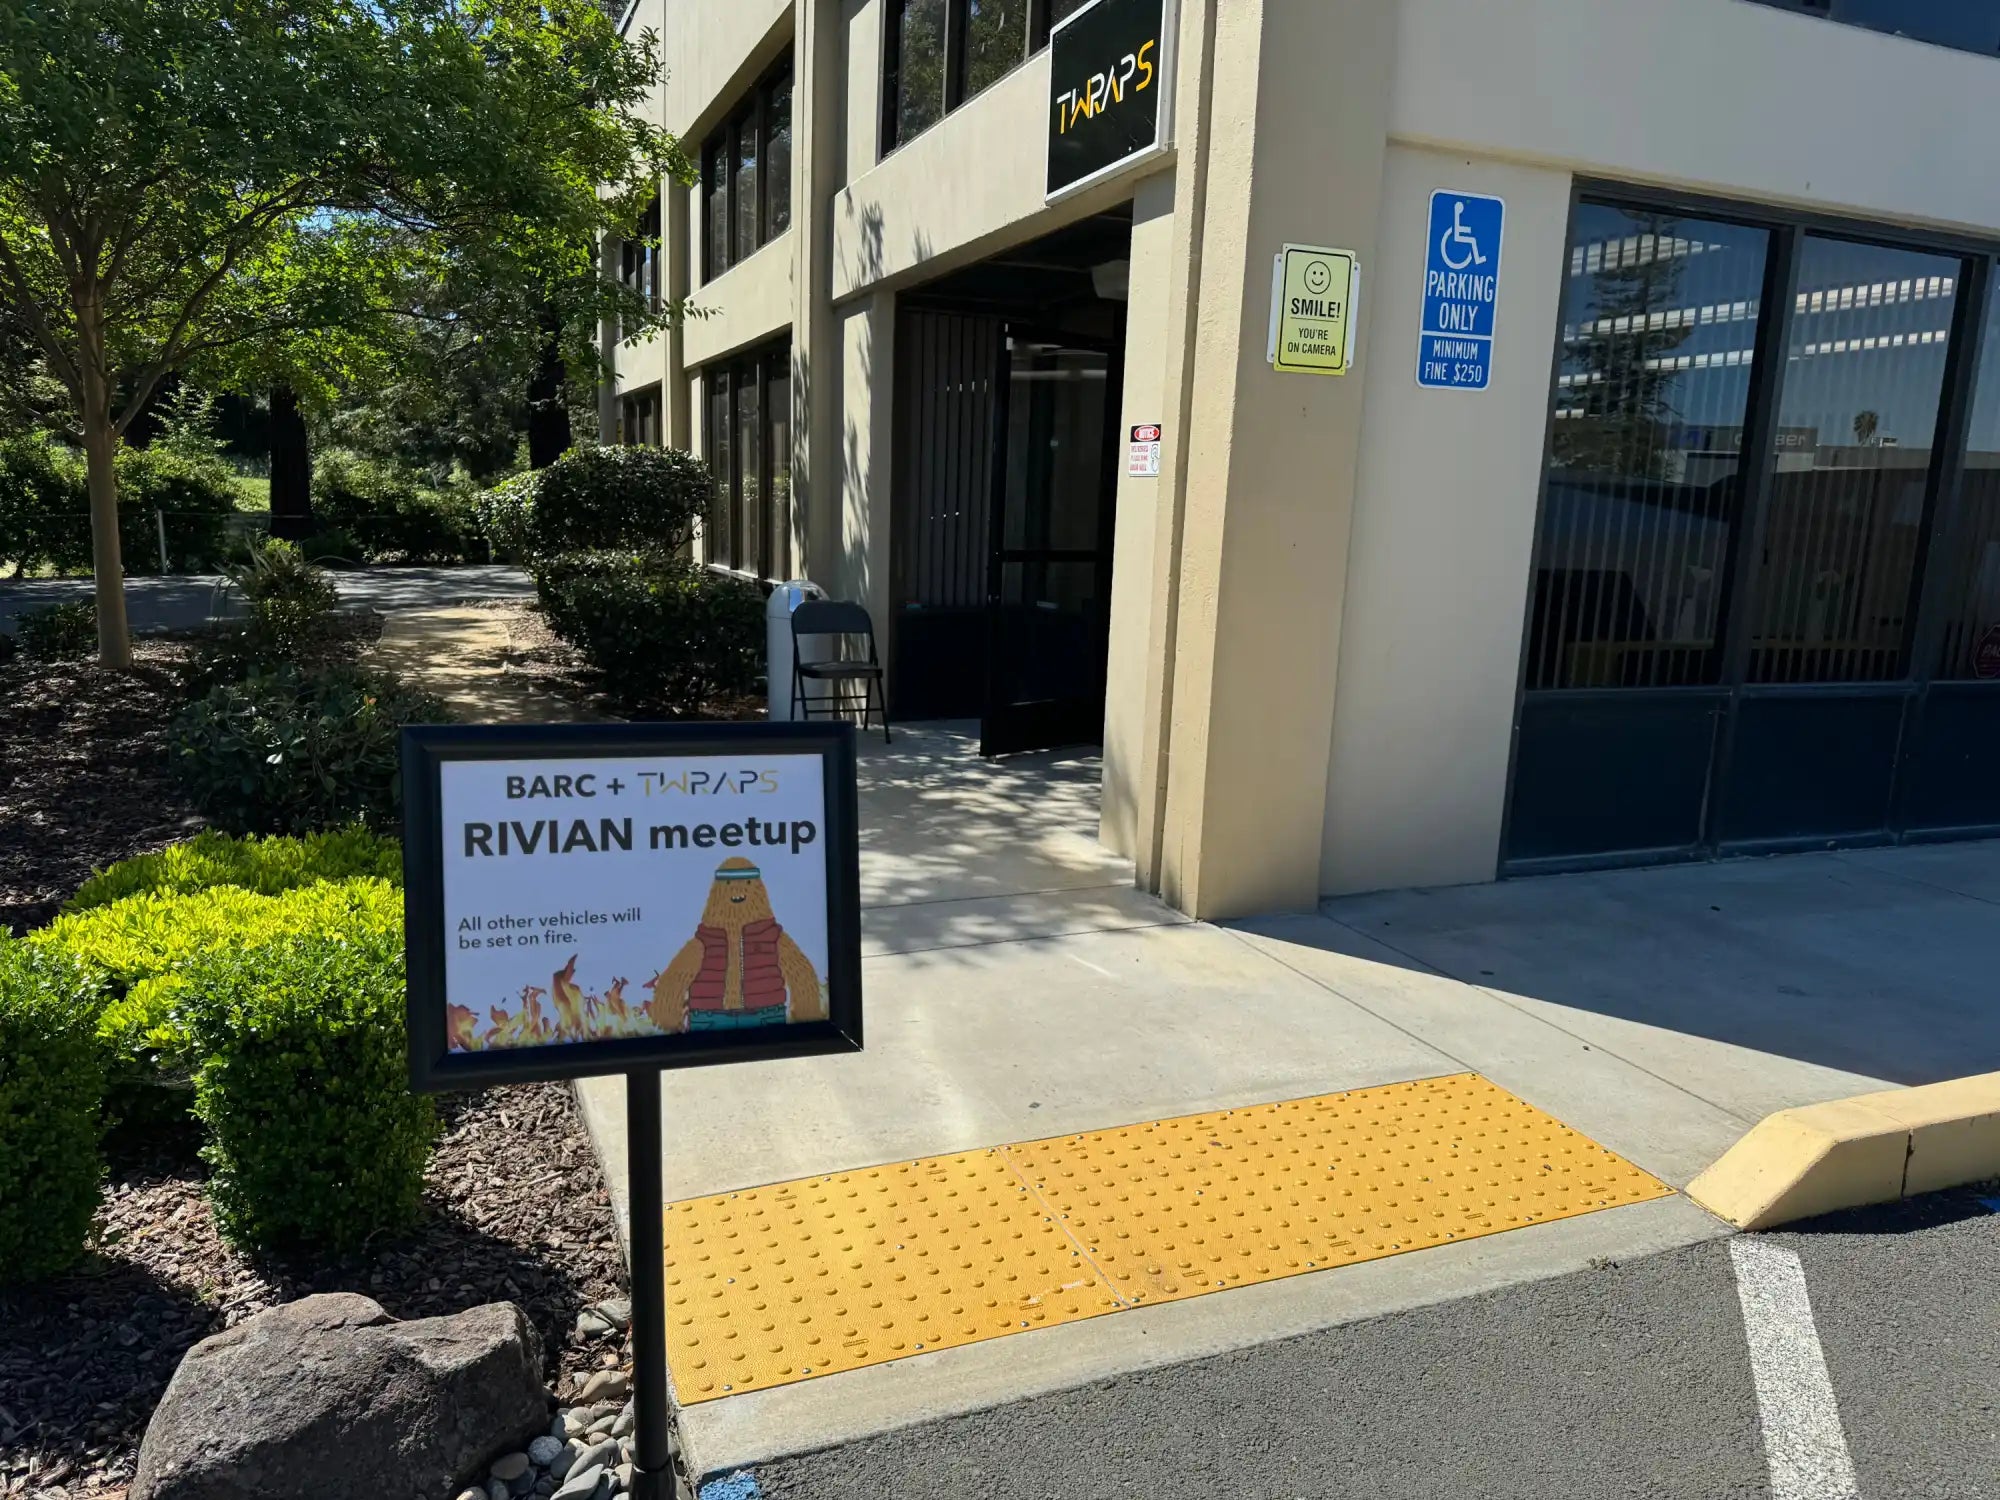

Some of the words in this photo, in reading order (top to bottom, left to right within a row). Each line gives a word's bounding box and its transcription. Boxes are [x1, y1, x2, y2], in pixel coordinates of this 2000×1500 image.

[1056, 39, 1154, 134] TWRAPS
[1428, 270, 1494, 302] PARKING
[1290, 297, 1341, 318] SMILE!
[1438, 302, 1479, 331] ONLY
[1298, 327, 1329, 341] YOU'RE
[1287, 342, 1300, 353] ON
[1302, 343, 1336, 356] CAMERA
[1432, 340, 1479, 360] MINIMUM
[1424, 361, 1448, 381] FINE
[1453, 362, 1482, 383] $250
[506, 773, 596, 799] BARC
[637, 770, 779, 797] TWRAPS
[464, 817, 633, 857] RIVIAN
[650, 817, 816, 854] meetup
[458, 916, 481, 932] All
[487, 915, 534, 930] other
[539, 910, 608, 927] vehicles
[612, 907, 641, 923] will
[458, 935, 481, 949] be
[486, 935, 512, 948] set
[518, 934, 539, 946] on
[544, 929, 578, 944] fire.
